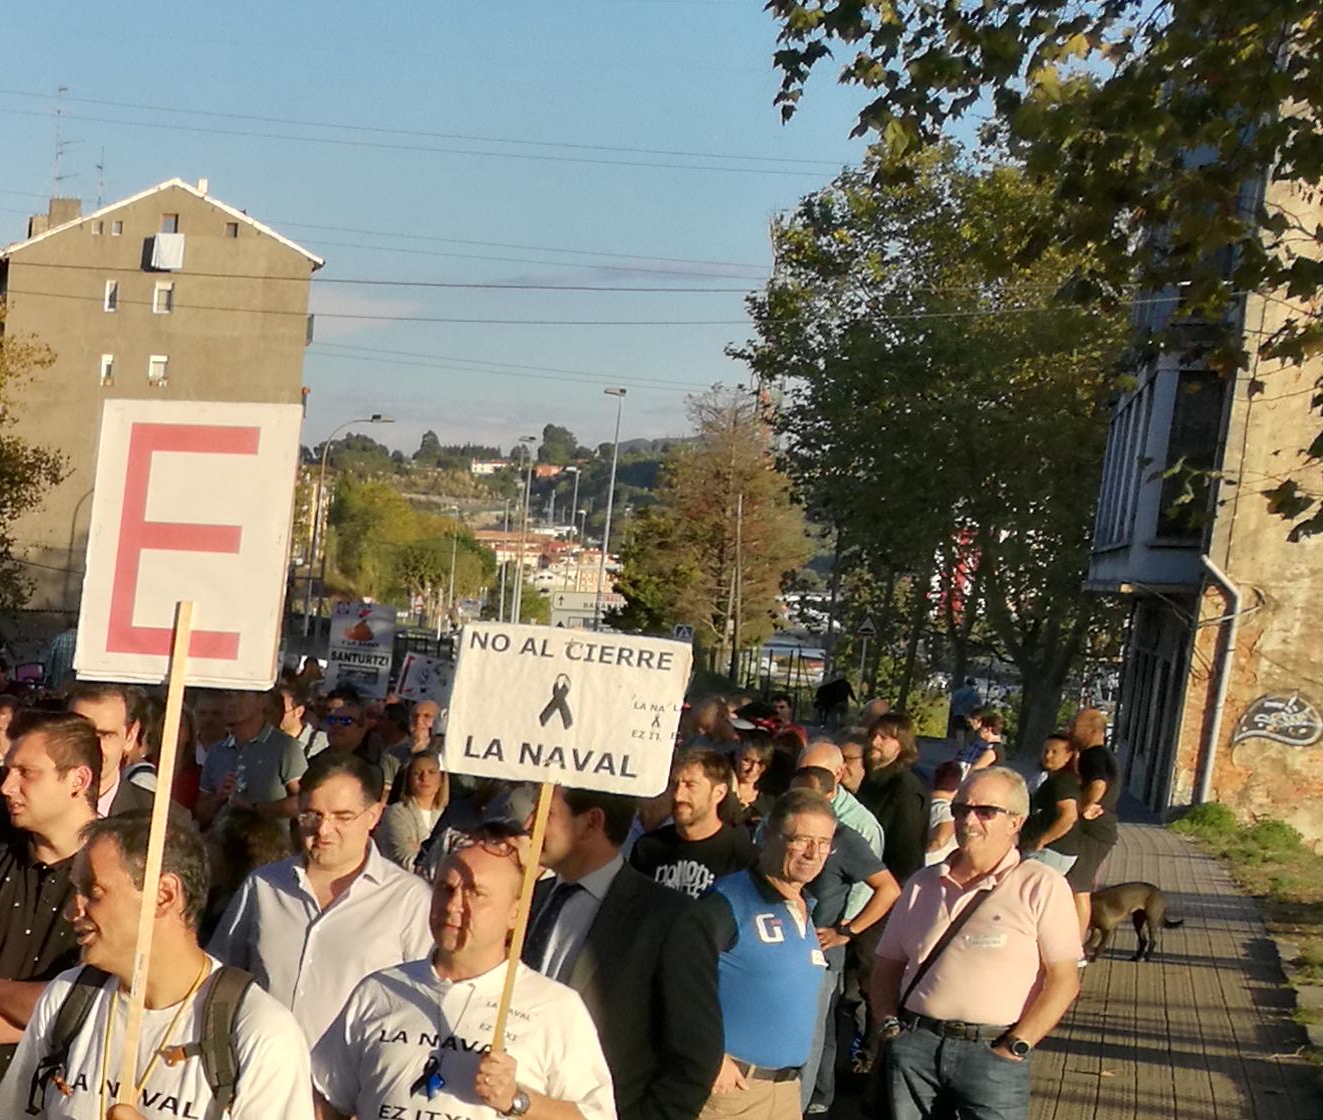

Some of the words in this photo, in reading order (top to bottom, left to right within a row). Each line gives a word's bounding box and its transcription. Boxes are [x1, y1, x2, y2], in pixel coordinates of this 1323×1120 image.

[105, 422, 262, 661] E
[331, 650, 389, 667] SANTURTZI
[469, 630, 511, 653] NO
[519, 637, 555, 658] AL
[564, 638, 674, 671] CIERRE
[463, 735, 504, 763] LA
[518, 742, 638, 779] NAVAL
[378, 1029, 409, 1044] LA
[418, 1032, 495, 1056] NAVA
[99, 1079, 200, 1120] NVAL
